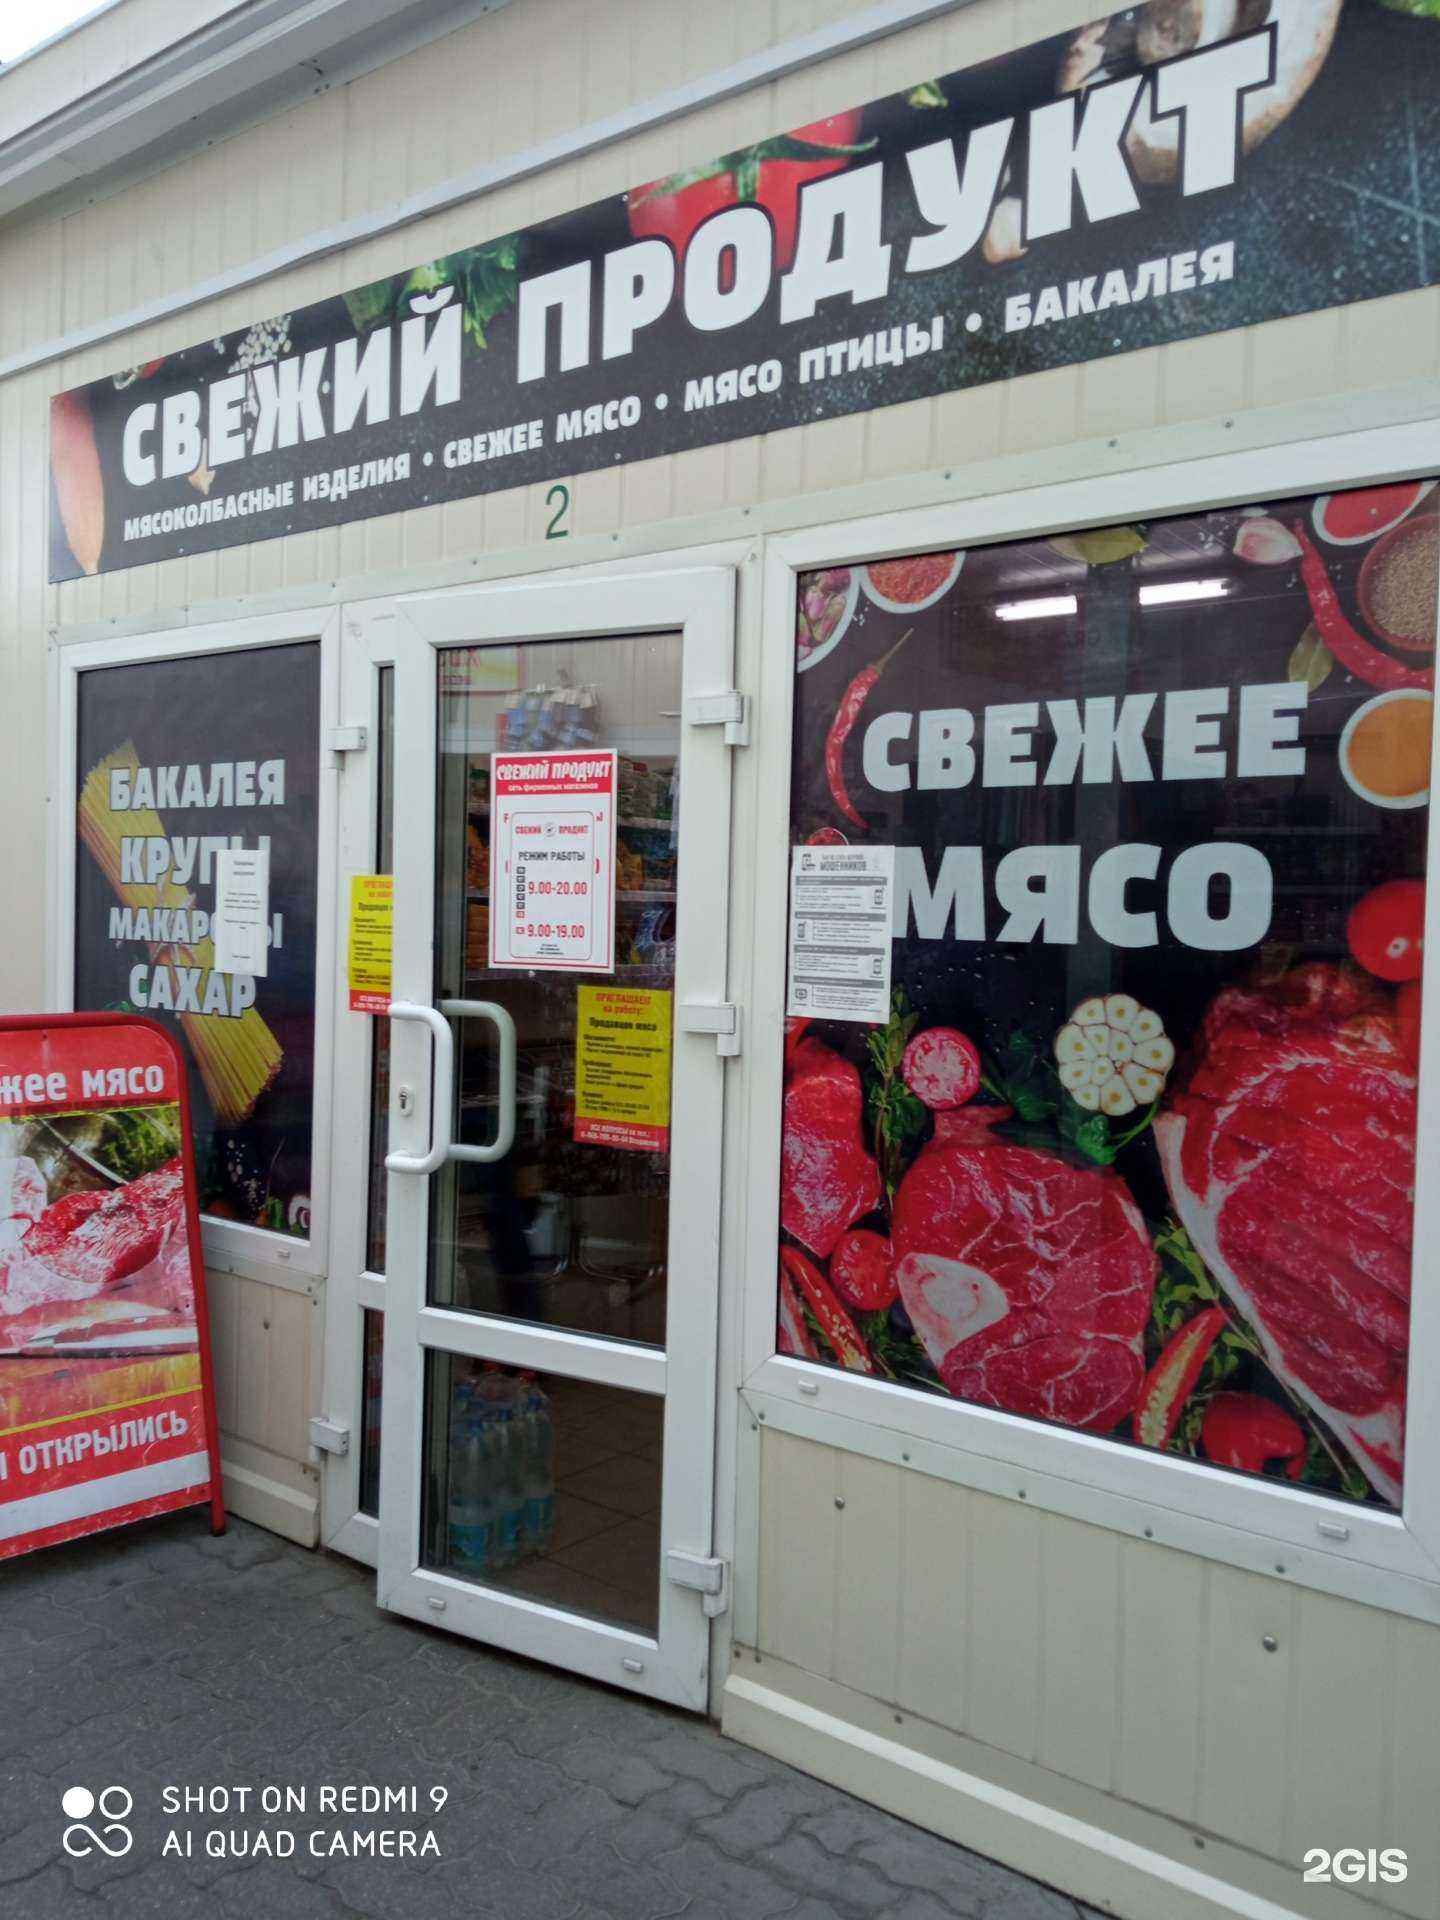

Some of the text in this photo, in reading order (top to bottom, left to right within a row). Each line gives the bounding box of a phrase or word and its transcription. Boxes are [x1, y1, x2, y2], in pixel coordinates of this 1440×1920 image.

[122, 21, 1278, 487] СВЕЖИЙ ПРОДУКТ
[123, 240, 1236, 542] МЯСОКОЛБАСНЫЕ ИЗДЕЛИЯ СВЕЖЕЕ МЯСО МЯСО ПТИЦЫ БАКАЛЕЯ
[545, 484, 570, 541] 2
[862, 680, 1309, 793] СВЕЖЕЕ
[109, 758, 286, 811] БАКАЛЕЯ
[120, 836, 271, 886] КРУП
[892, 841, 1274, 952] МЯСО
[129, 963, 257, 1019] САХАР
[18, 1410, 189, 1475] ОТКРЫЛИСЬ
